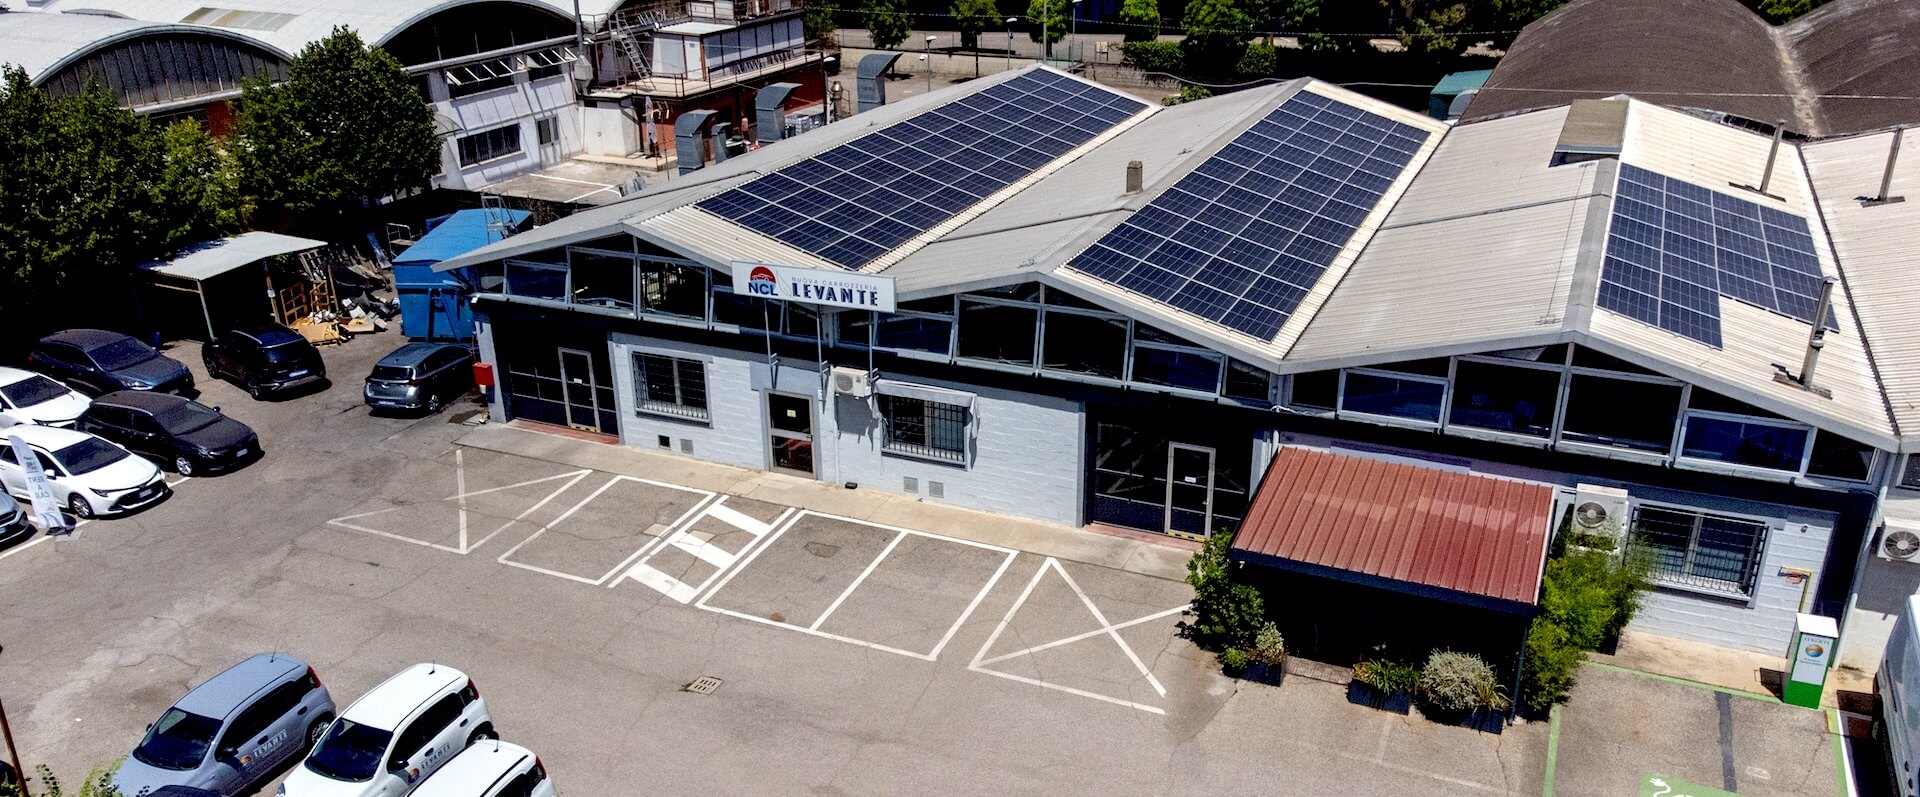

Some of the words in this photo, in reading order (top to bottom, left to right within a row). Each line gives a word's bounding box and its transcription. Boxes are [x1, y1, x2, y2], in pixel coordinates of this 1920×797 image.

[748, 282, 779, 297] NCL
[791, 282, 878, 307] LEVANTE
[792, 276, 818, 285] NUOVA
[822, 279, 878, 291] CARROZZERIA
[253, 731, 288, 757] LEVANTE
[421, 743, 450, 769] LEVANTE
